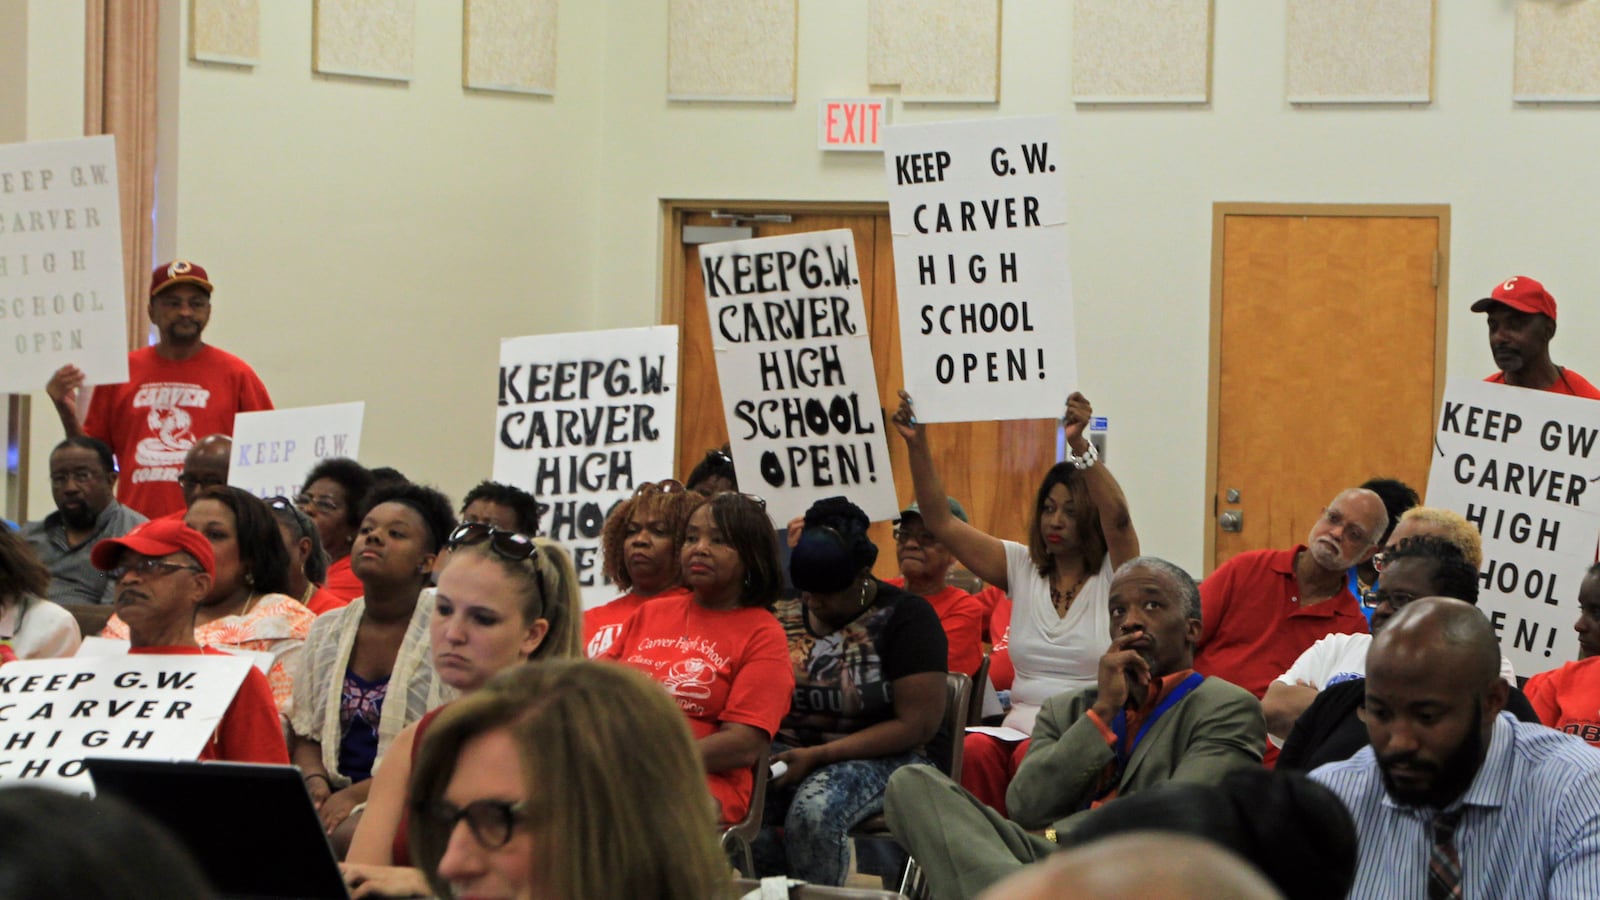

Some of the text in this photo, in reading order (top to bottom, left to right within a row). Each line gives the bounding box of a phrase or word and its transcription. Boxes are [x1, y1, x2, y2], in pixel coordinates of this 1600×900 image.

[826, 103, 882, 144] EXIT
[2, 164, 108, 193] EEP G.W.
[896, 151, 951, 185] KEEP
[913, 196, 1041, 234] CARVER
[918, 252, 1018, 285] HIGH
[1503, 277, 1518, 290] C
[718, 297, 856, 344] CARVER
[921, 301, 1034, 335] SCHOOL
[15, 329, 83, 354] OPEN
[759, 345, 845, 391] HIGH
[936, 348, 1046, 384] OPEN!
[500, 404, 660, 450] CARVER
[734, 392, 875, 440] SCHOOL
[1442, 401, 1599, 459] KEEP GW
[237, 434, 348, 466] KEEP G.W.
[760, 442, 877, 488] OPEN!
[535, 451, 634, 495] HIGH
[1454, 453, 1587, 506] CARVER
[1466, 503, 1560, 551] HIGH
[1479, 560, 1558, 606] HOOL
[638, 635, 730, 669] Carver High School
[1491, 610, 1557, 657] EN!
[114, 671, 197, 690] G.W.
[4, 730, 154, 750] HIGH
